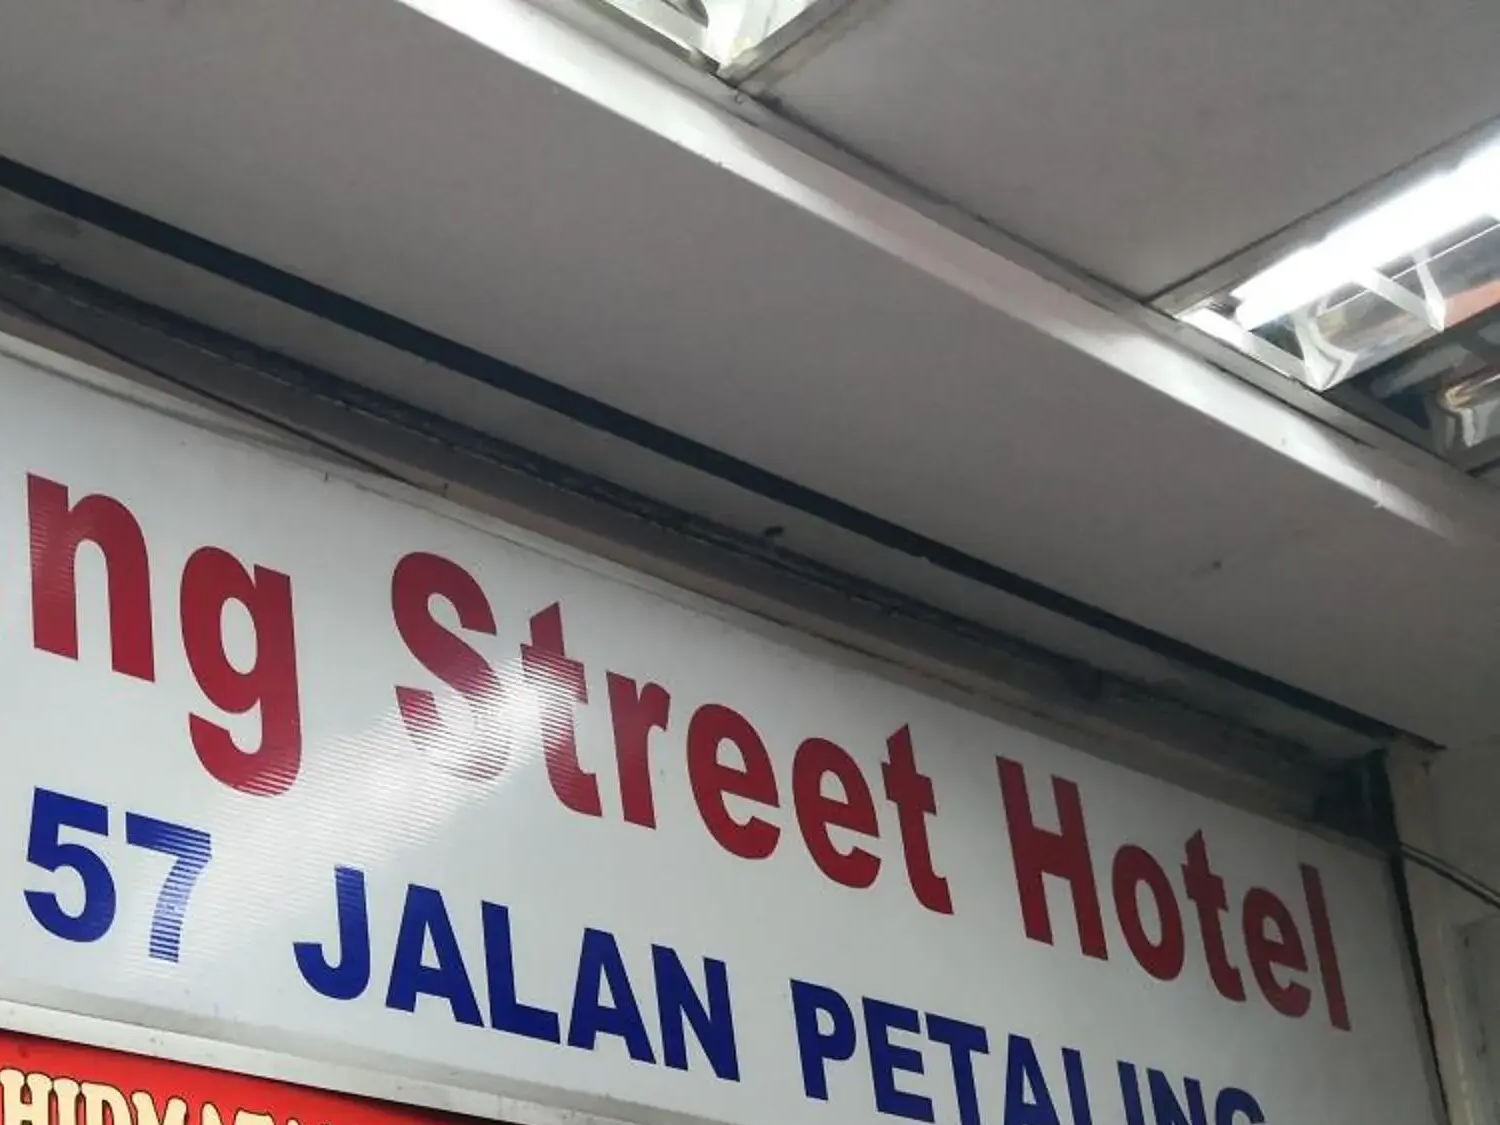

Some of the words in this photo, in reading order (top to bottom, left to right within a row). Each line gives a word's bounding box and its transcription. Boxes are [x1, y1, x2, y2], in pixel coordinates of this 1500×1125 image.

[24, 787, 213, 964] 57
[293, 864, 742, 1083] JALAN
[392, 551, 954, 915] Street
[995, 755, 1352, 1034] Hotel
